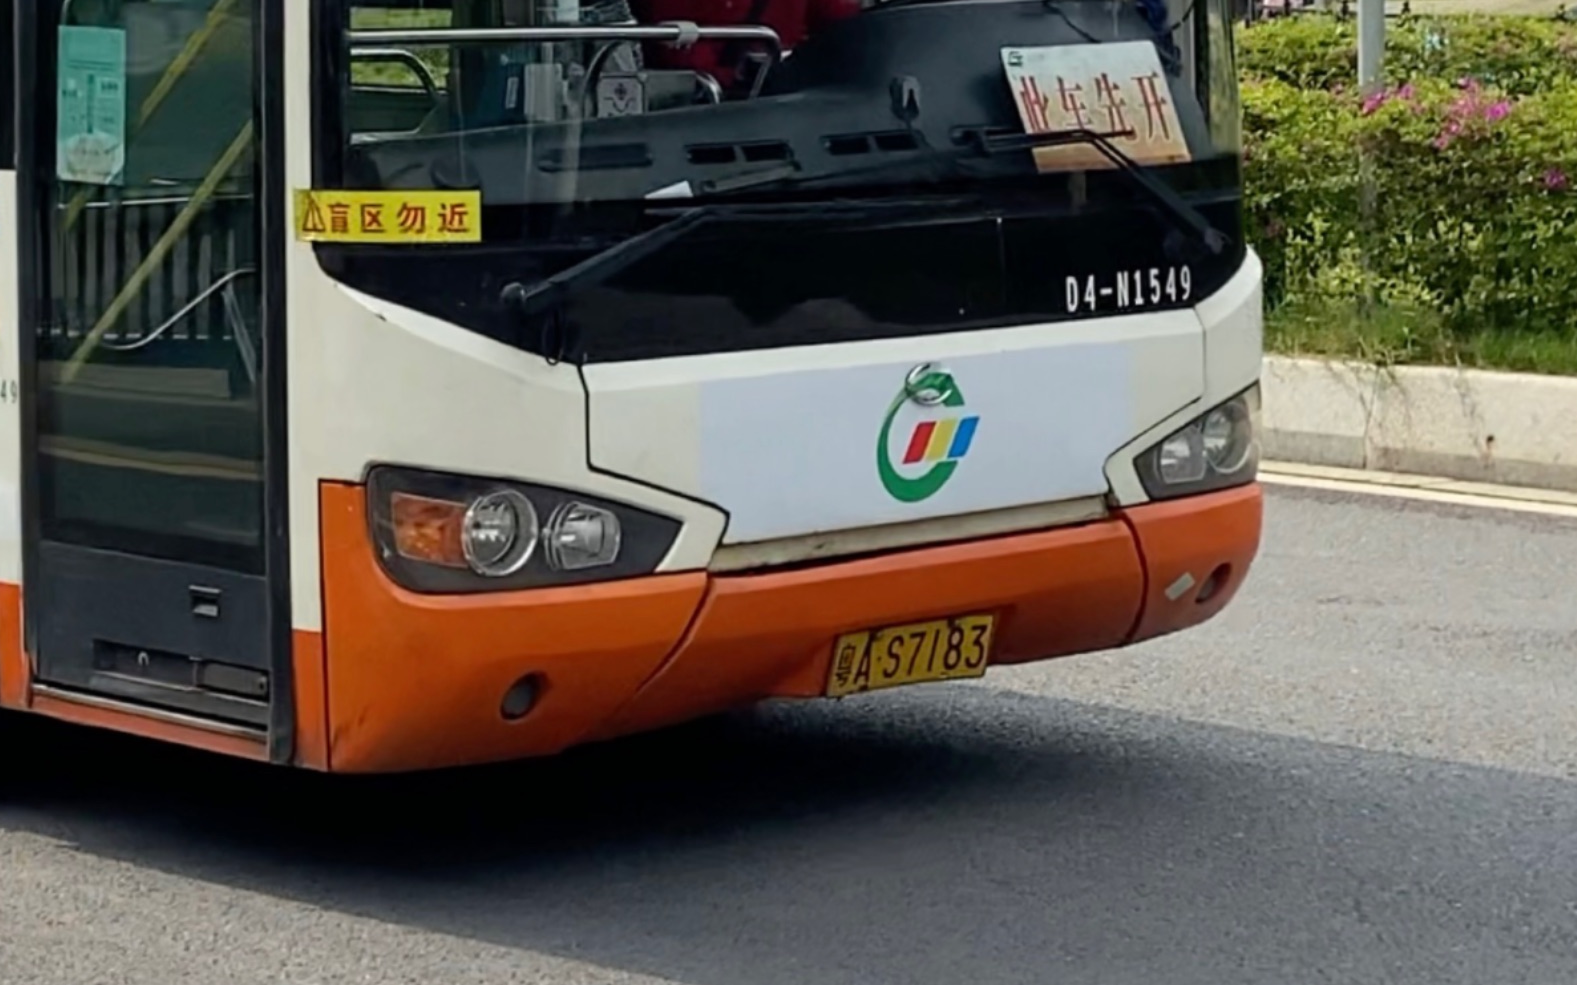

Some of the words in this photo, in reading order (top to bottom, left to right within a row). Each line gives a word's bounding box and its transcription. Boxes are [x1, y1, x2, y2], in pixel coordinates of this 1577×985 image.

[328, 201, 471, 234] 盲区勿近
[1065, 264, 1192, 313] D4-N1549
